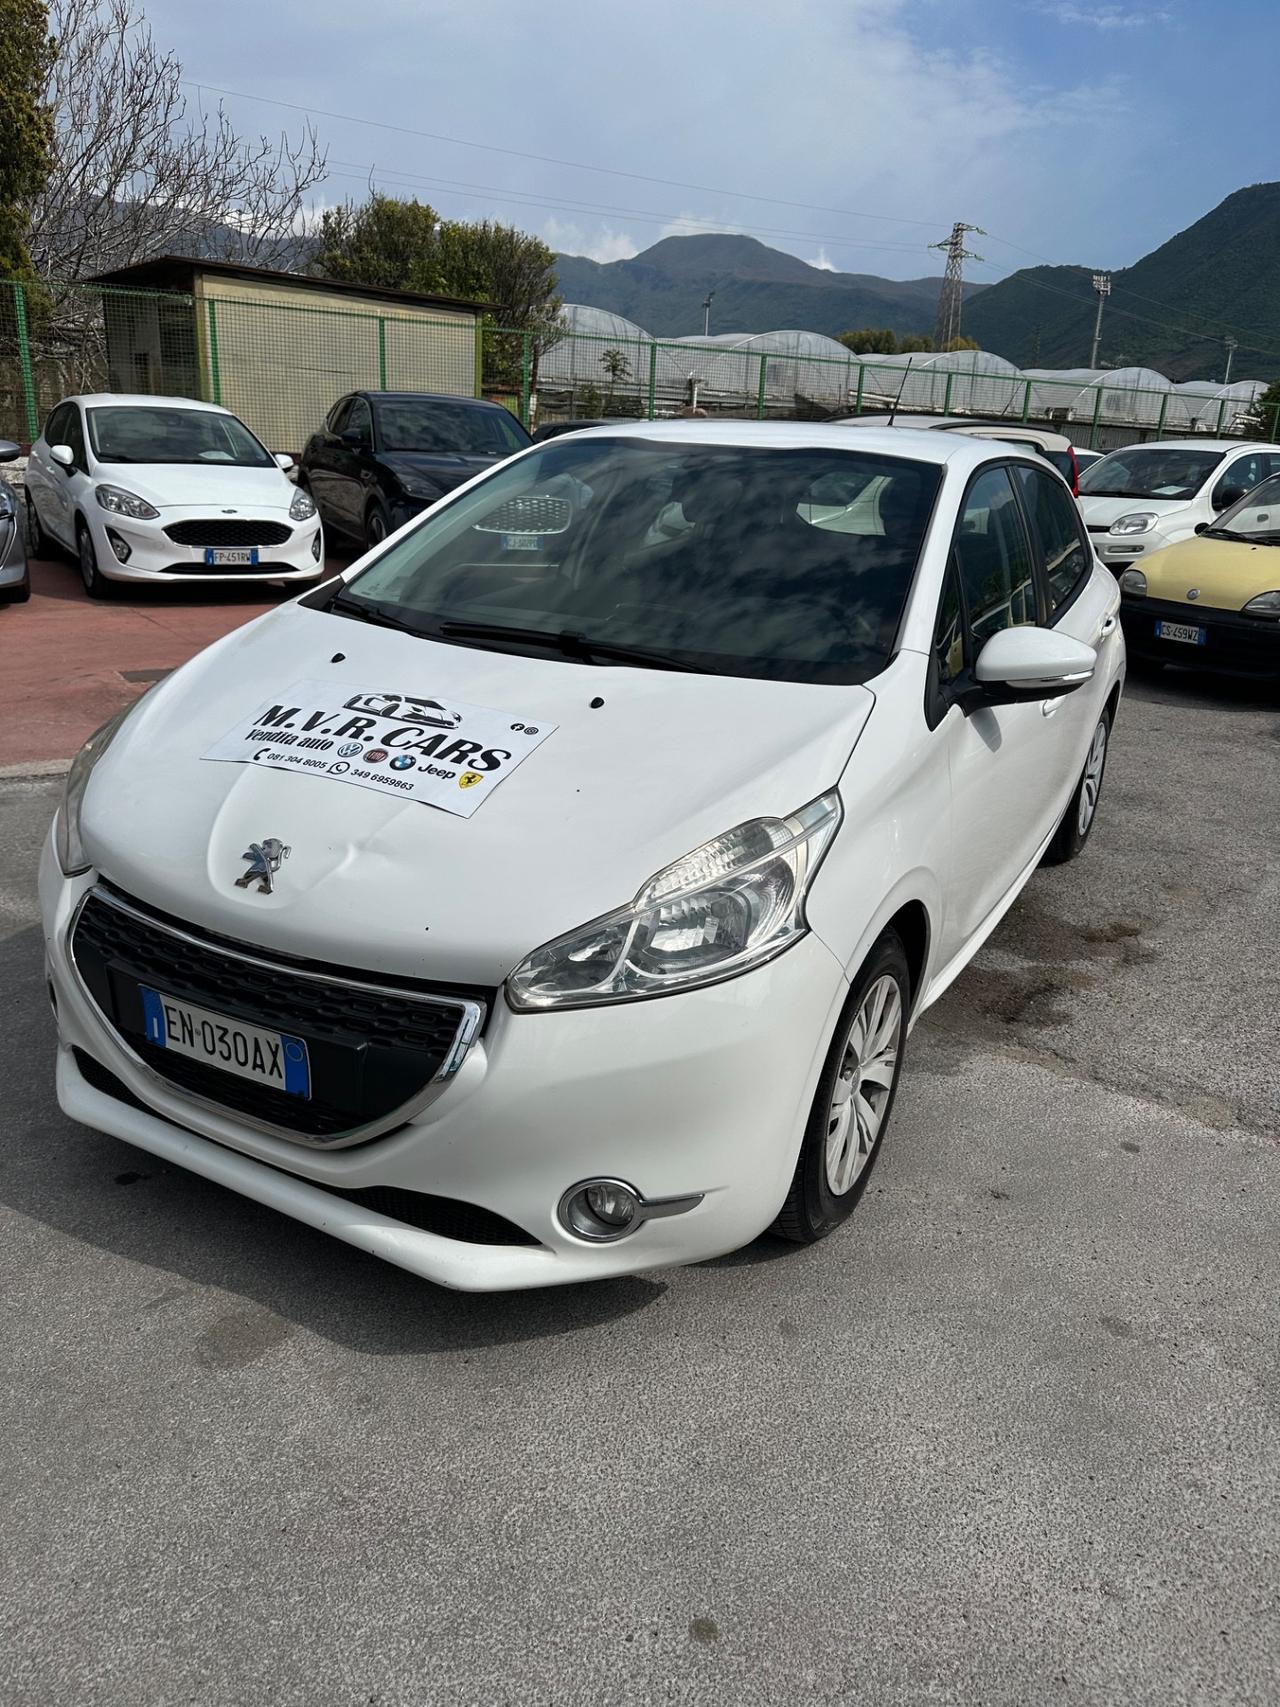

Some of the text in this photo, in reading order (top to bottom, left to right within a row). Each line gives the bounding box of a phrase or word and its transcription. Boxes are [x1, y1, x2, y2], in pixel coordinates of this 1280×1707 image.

[245, 728, 335, 751] Vendita auto
[266, 752, 328, 769] 081 304 8005
[350, 769, 415, 791] 349 6959863
[418, 763, 457, 780] Jeep
